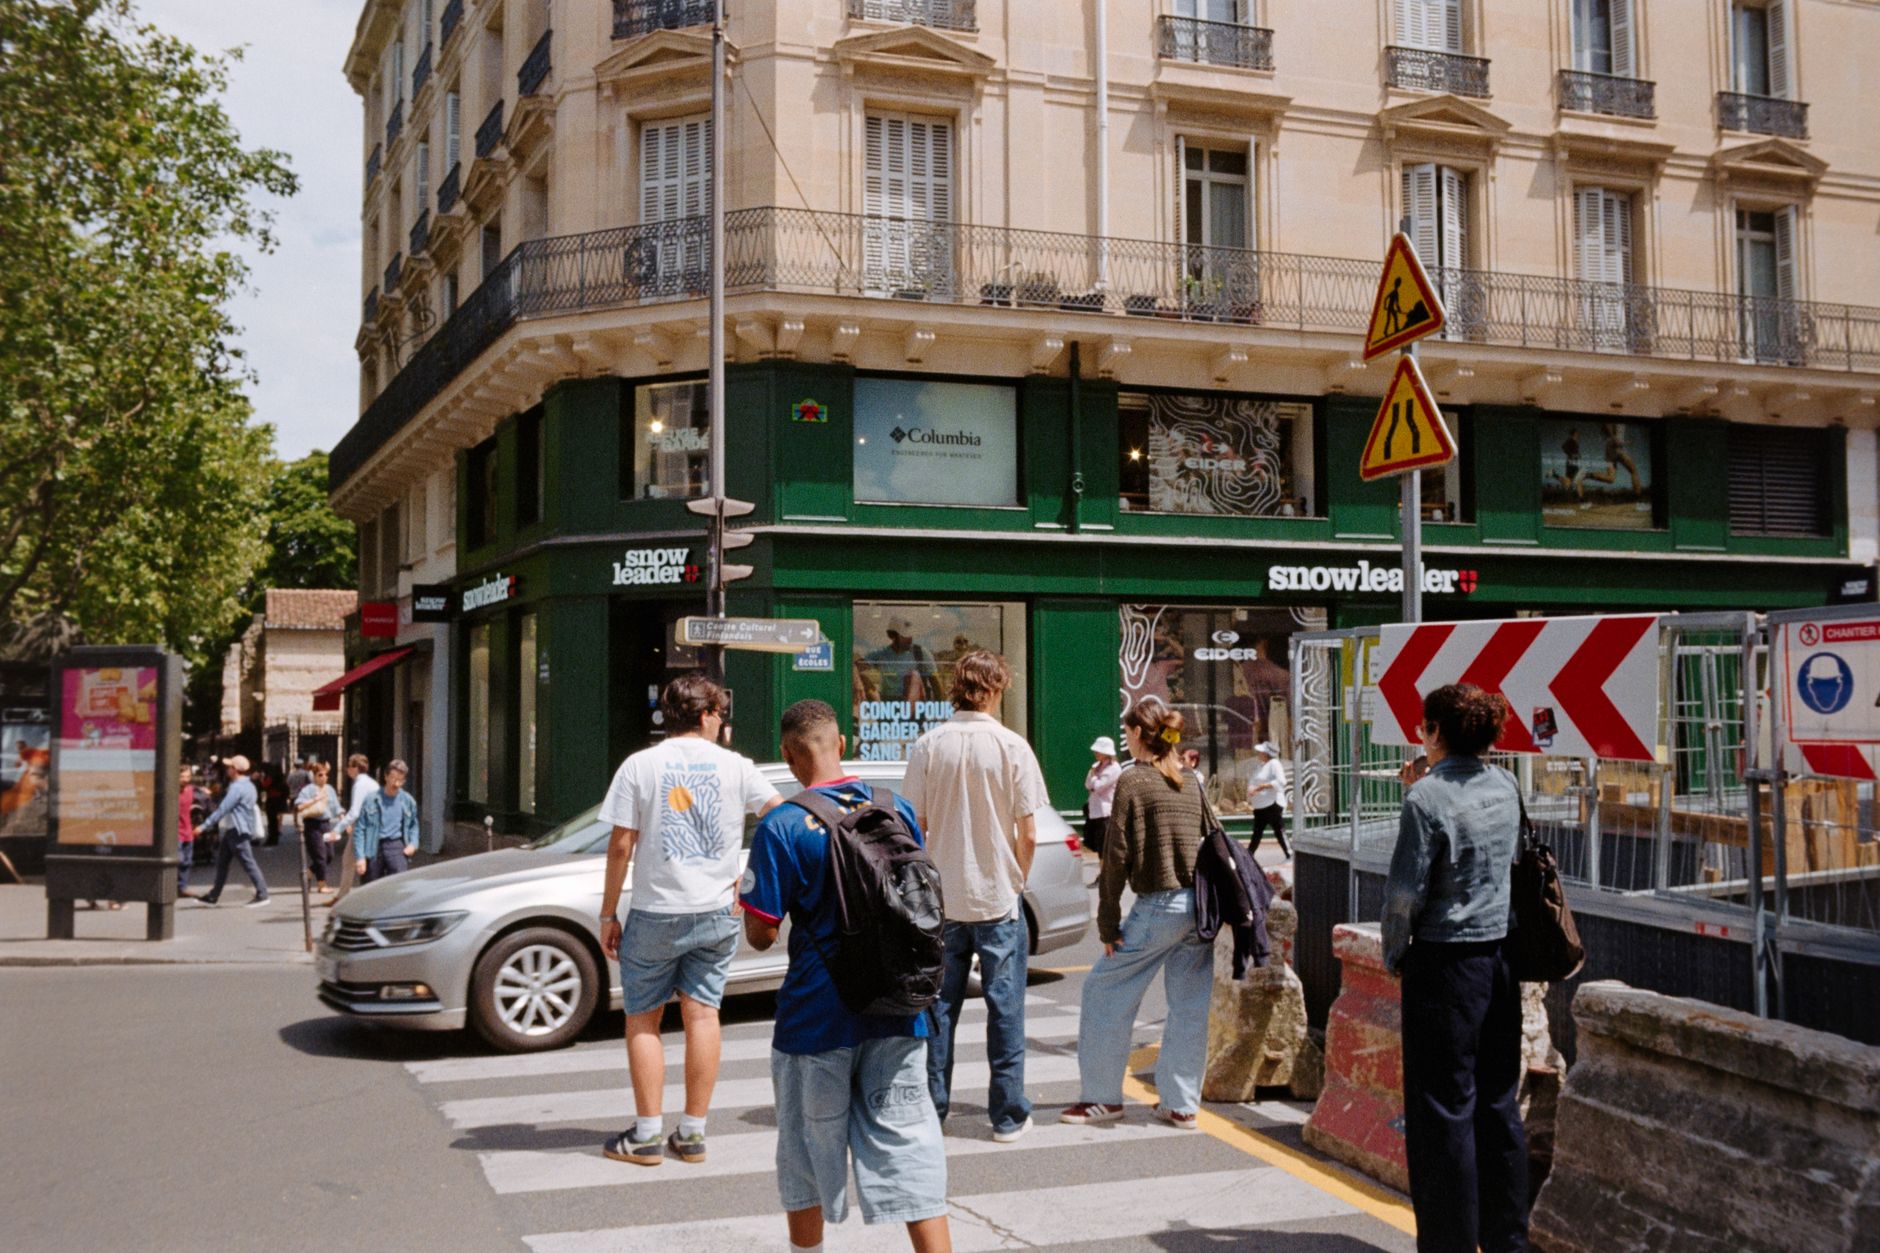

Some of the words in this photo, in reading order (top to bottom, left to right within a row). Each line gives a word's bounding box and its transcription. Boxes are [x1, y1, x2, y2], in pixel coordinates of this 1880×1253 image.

[908, 428, 981, 446] Columbia
[1184, 458, 1246, 471] EIDER
[625, 548, 689, 567] snow
[612, 562, 685, 585] leader
[1268, 560, 1459, 593] snowleaer
[707, 622, 736, 631] Centre
[740, 622, 777, 632] Culturel
[707, 631, 752, 640] Finlandais
[1826, 626, 1876, 639] CHANTIER
[798, 657, 828, 667] ÉCOLES
[1194, 647, 1257, 661] EIDER
[860, 701, 911, 723] CONÇU
[860, 721, 919, 741] GARDER
[860, 742, 901, 761] SANG
